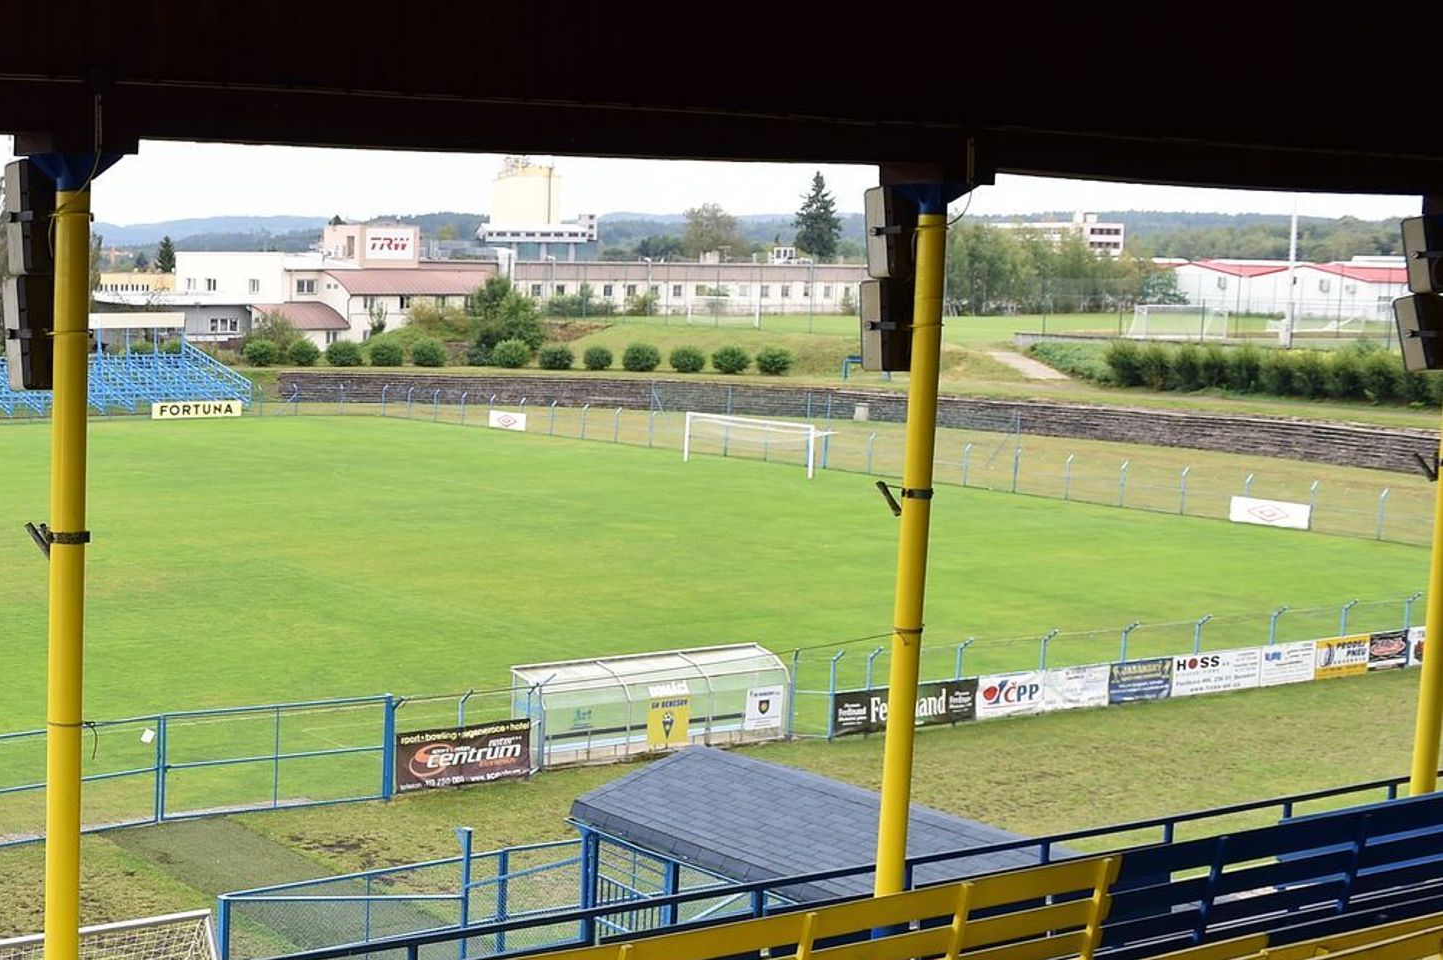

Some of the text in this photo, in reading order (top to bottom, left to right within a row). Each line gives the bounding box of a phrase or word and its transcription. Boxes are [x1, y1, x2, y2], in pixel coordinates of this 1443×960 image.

[370, 237, 409, 251] TRW
[159, 403, 233, 416] FORTUNA
[1176, 655, 1220, 671] HOSS
[1005, 681, 1039, 703] ČPP
[426, 743, 521, 769] centrum
